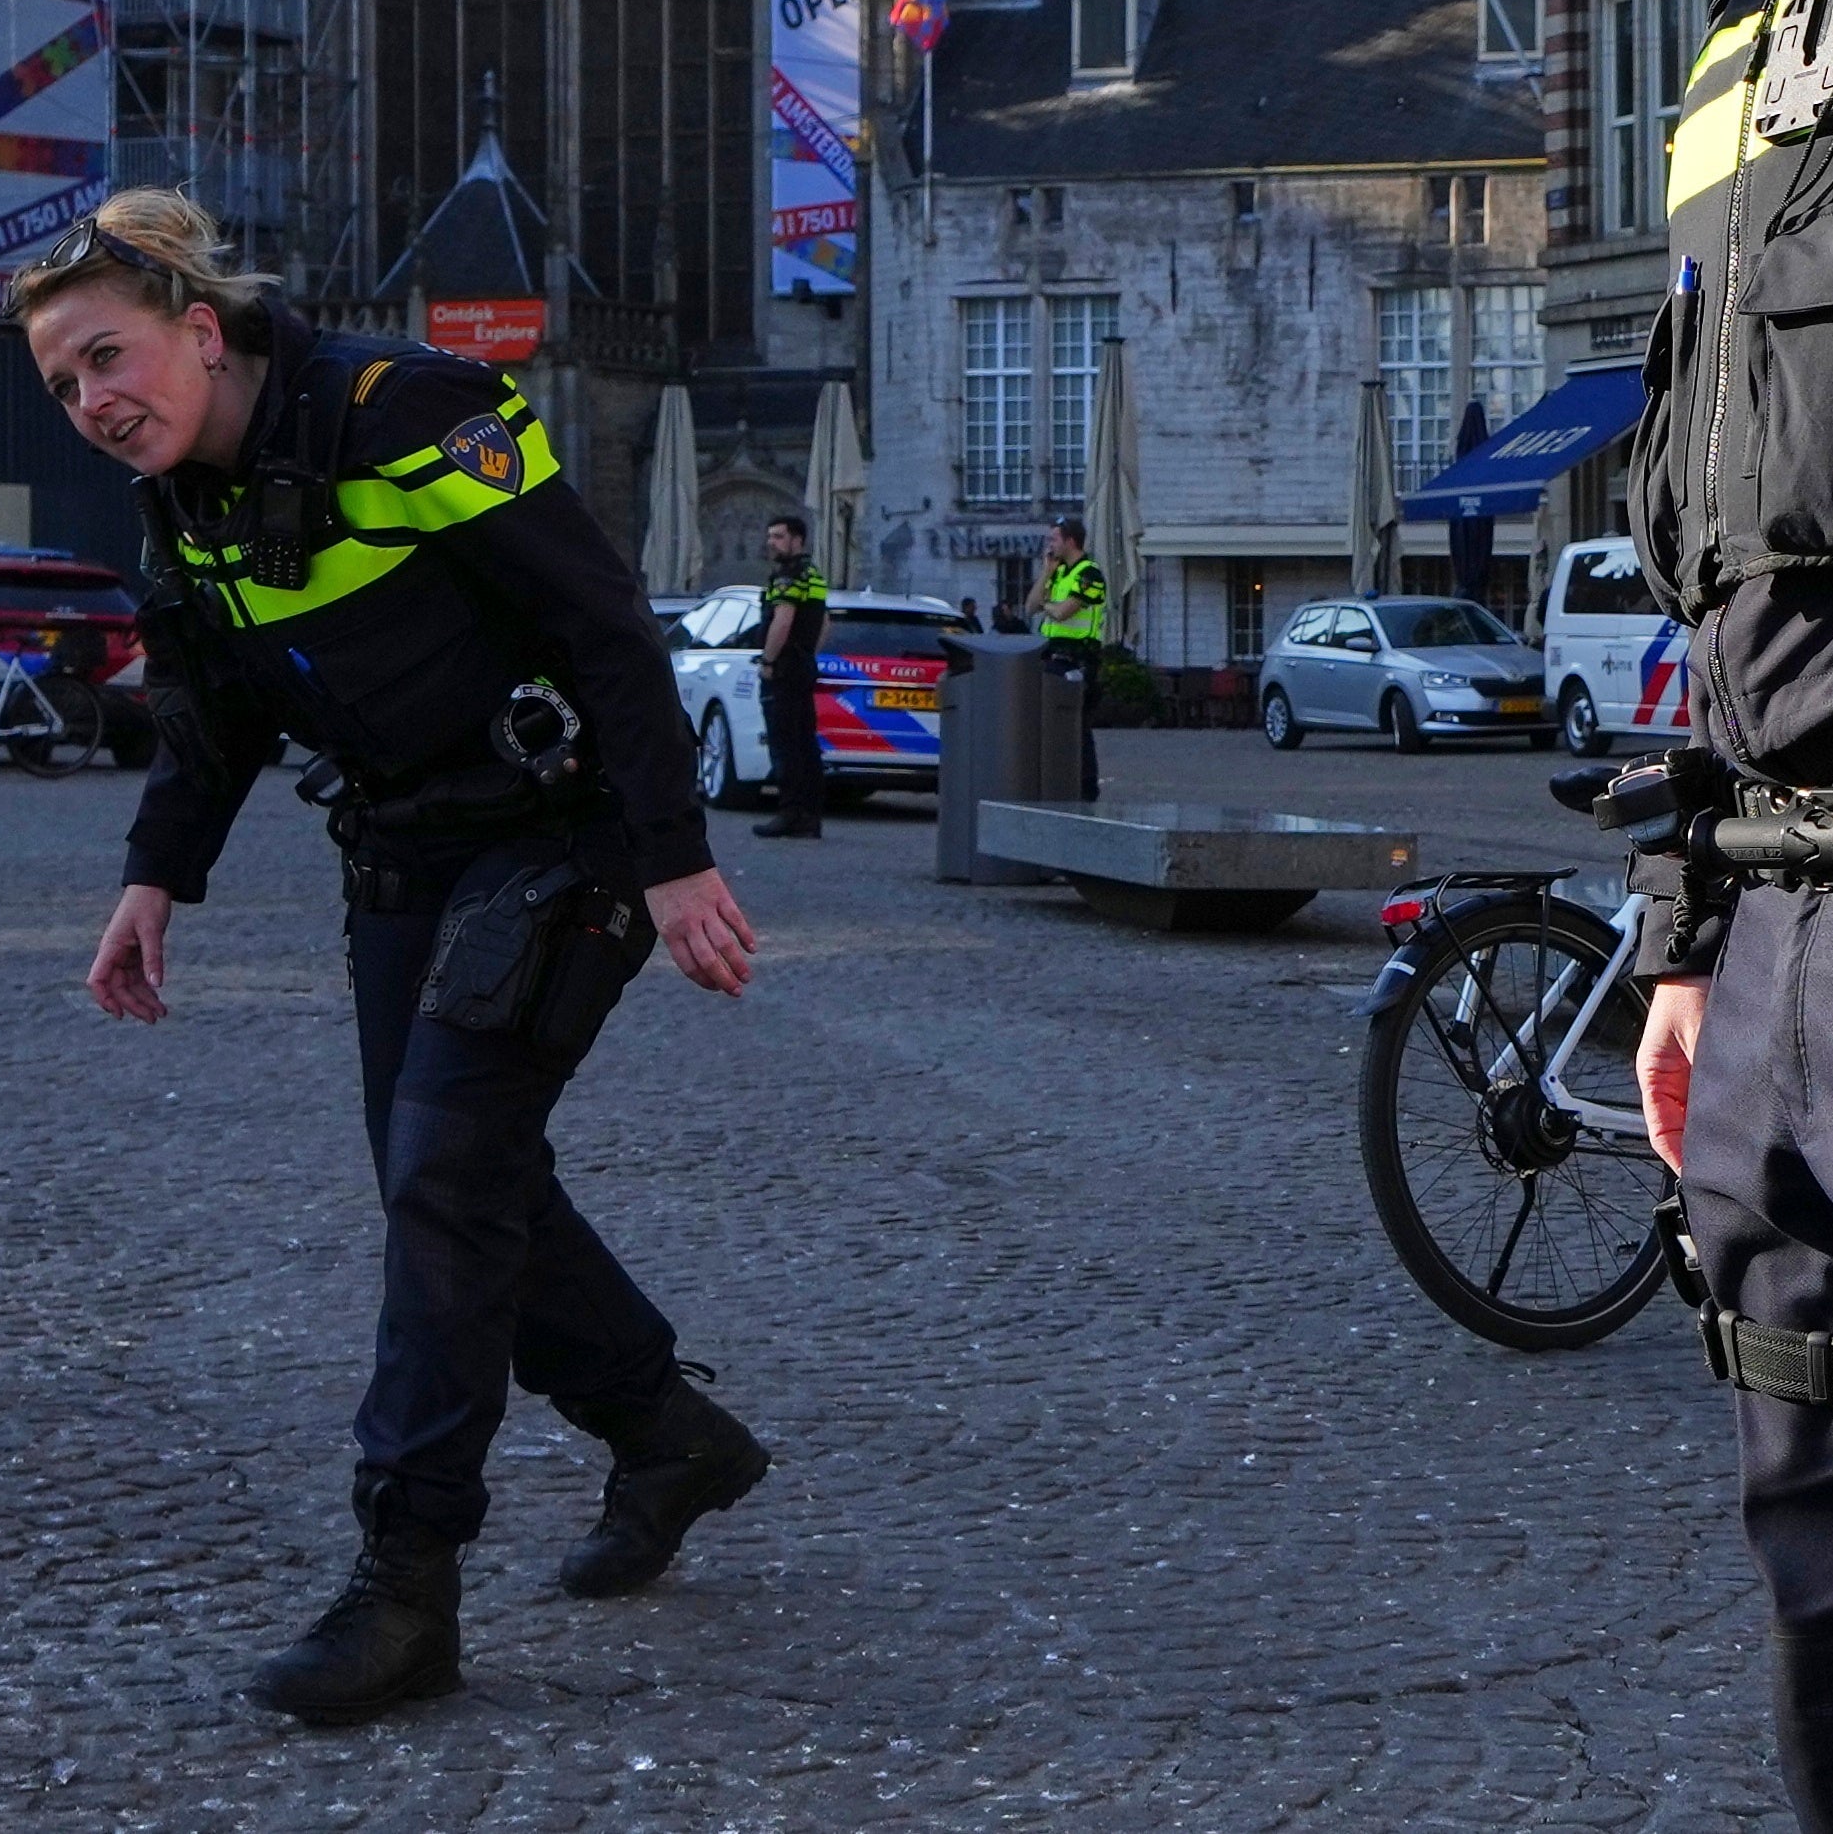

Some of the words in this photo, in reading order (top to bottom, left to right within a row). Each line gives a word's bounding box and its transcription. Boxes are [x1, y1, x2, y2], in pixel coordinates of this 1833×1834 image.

[17, 200, 58, 238] 750
[798, 206, 836, 234] 750
[432, 305, 495, 324] Ontdek
[474, 323, 538, 344] Explore
[450, 422, 499, 456] POLITIE
[949, 527, 1045, 558] Nieuw
[816, 660, 881, 674] POLITIE
